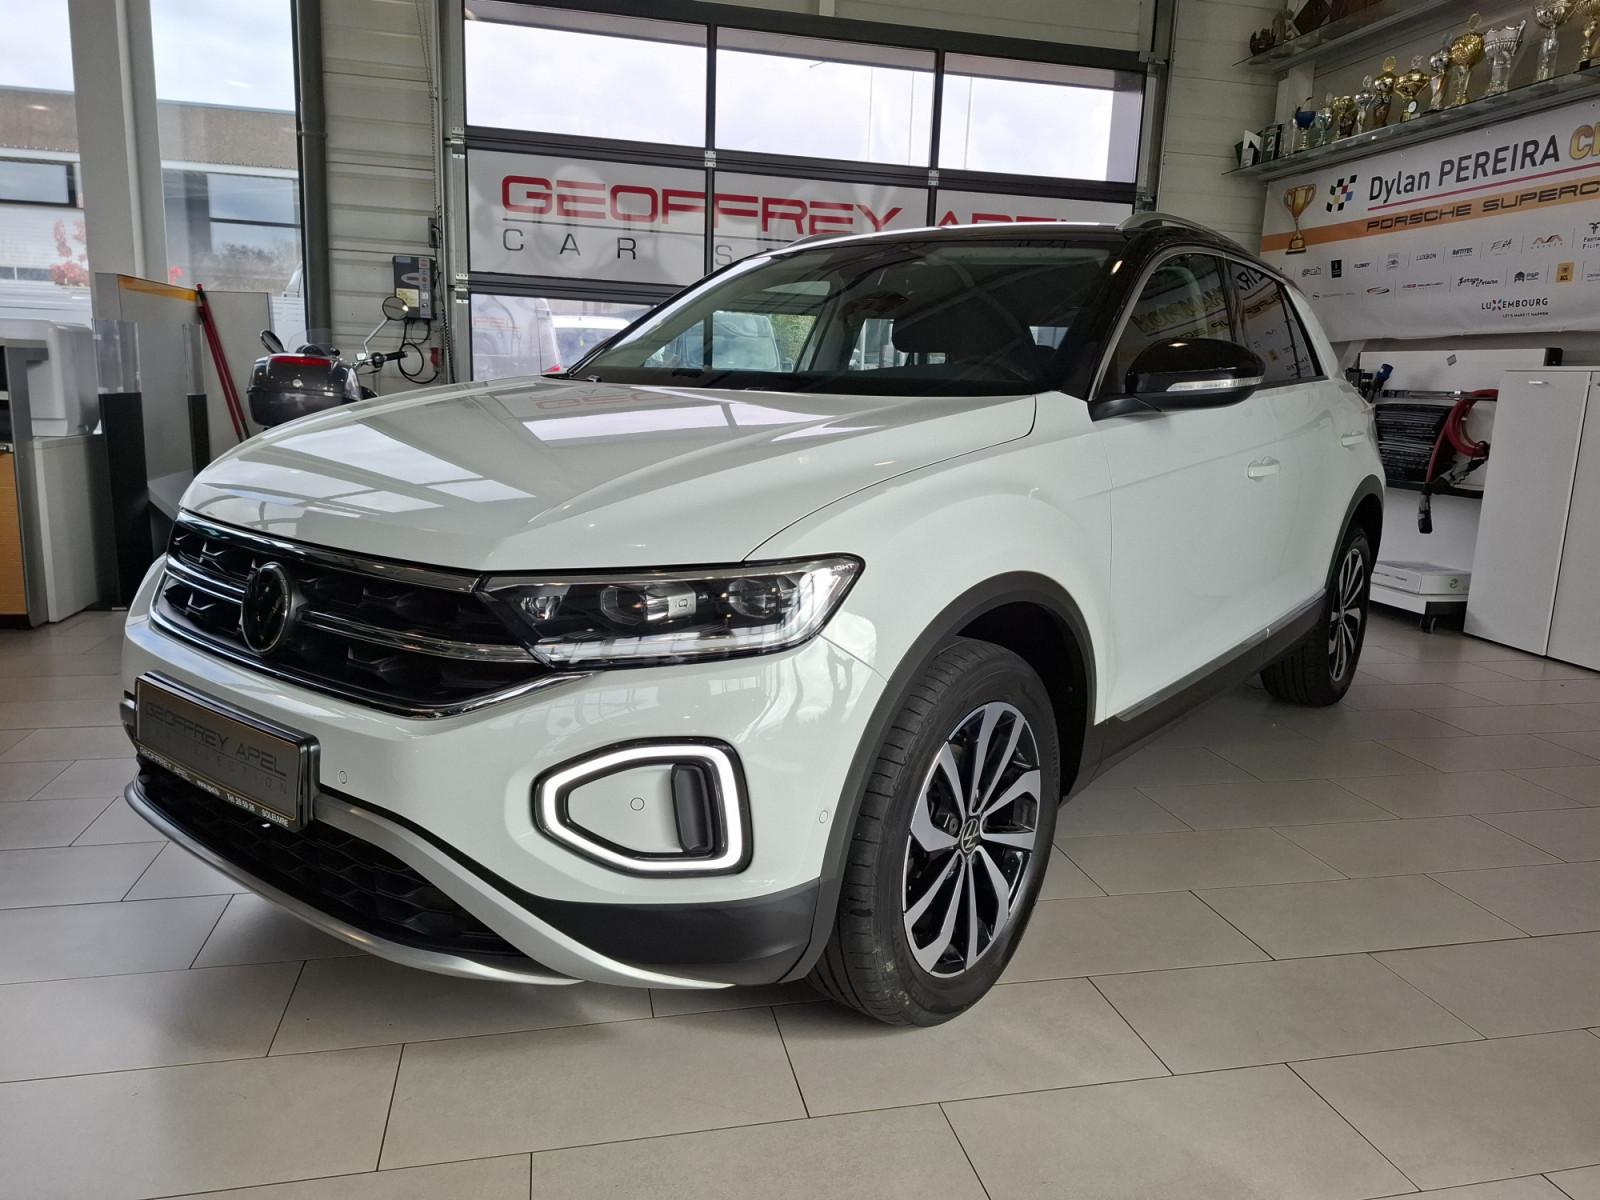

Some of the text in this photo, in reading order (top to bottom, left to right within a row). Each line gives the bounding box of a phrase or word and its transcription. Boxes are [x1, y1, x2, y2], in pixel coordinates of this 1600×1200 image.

[1369, 169, 1431, 203] Dylan
[1438, 135, 1560, 187] PEREIRA
[502, 175, 903, 235] GEOFFREY
[1366, 203, 1472, 233] PORSCHE
[1481, 298, 1549, 311] LUXEMBOURG
[236, 743, 287, 777] APEL
